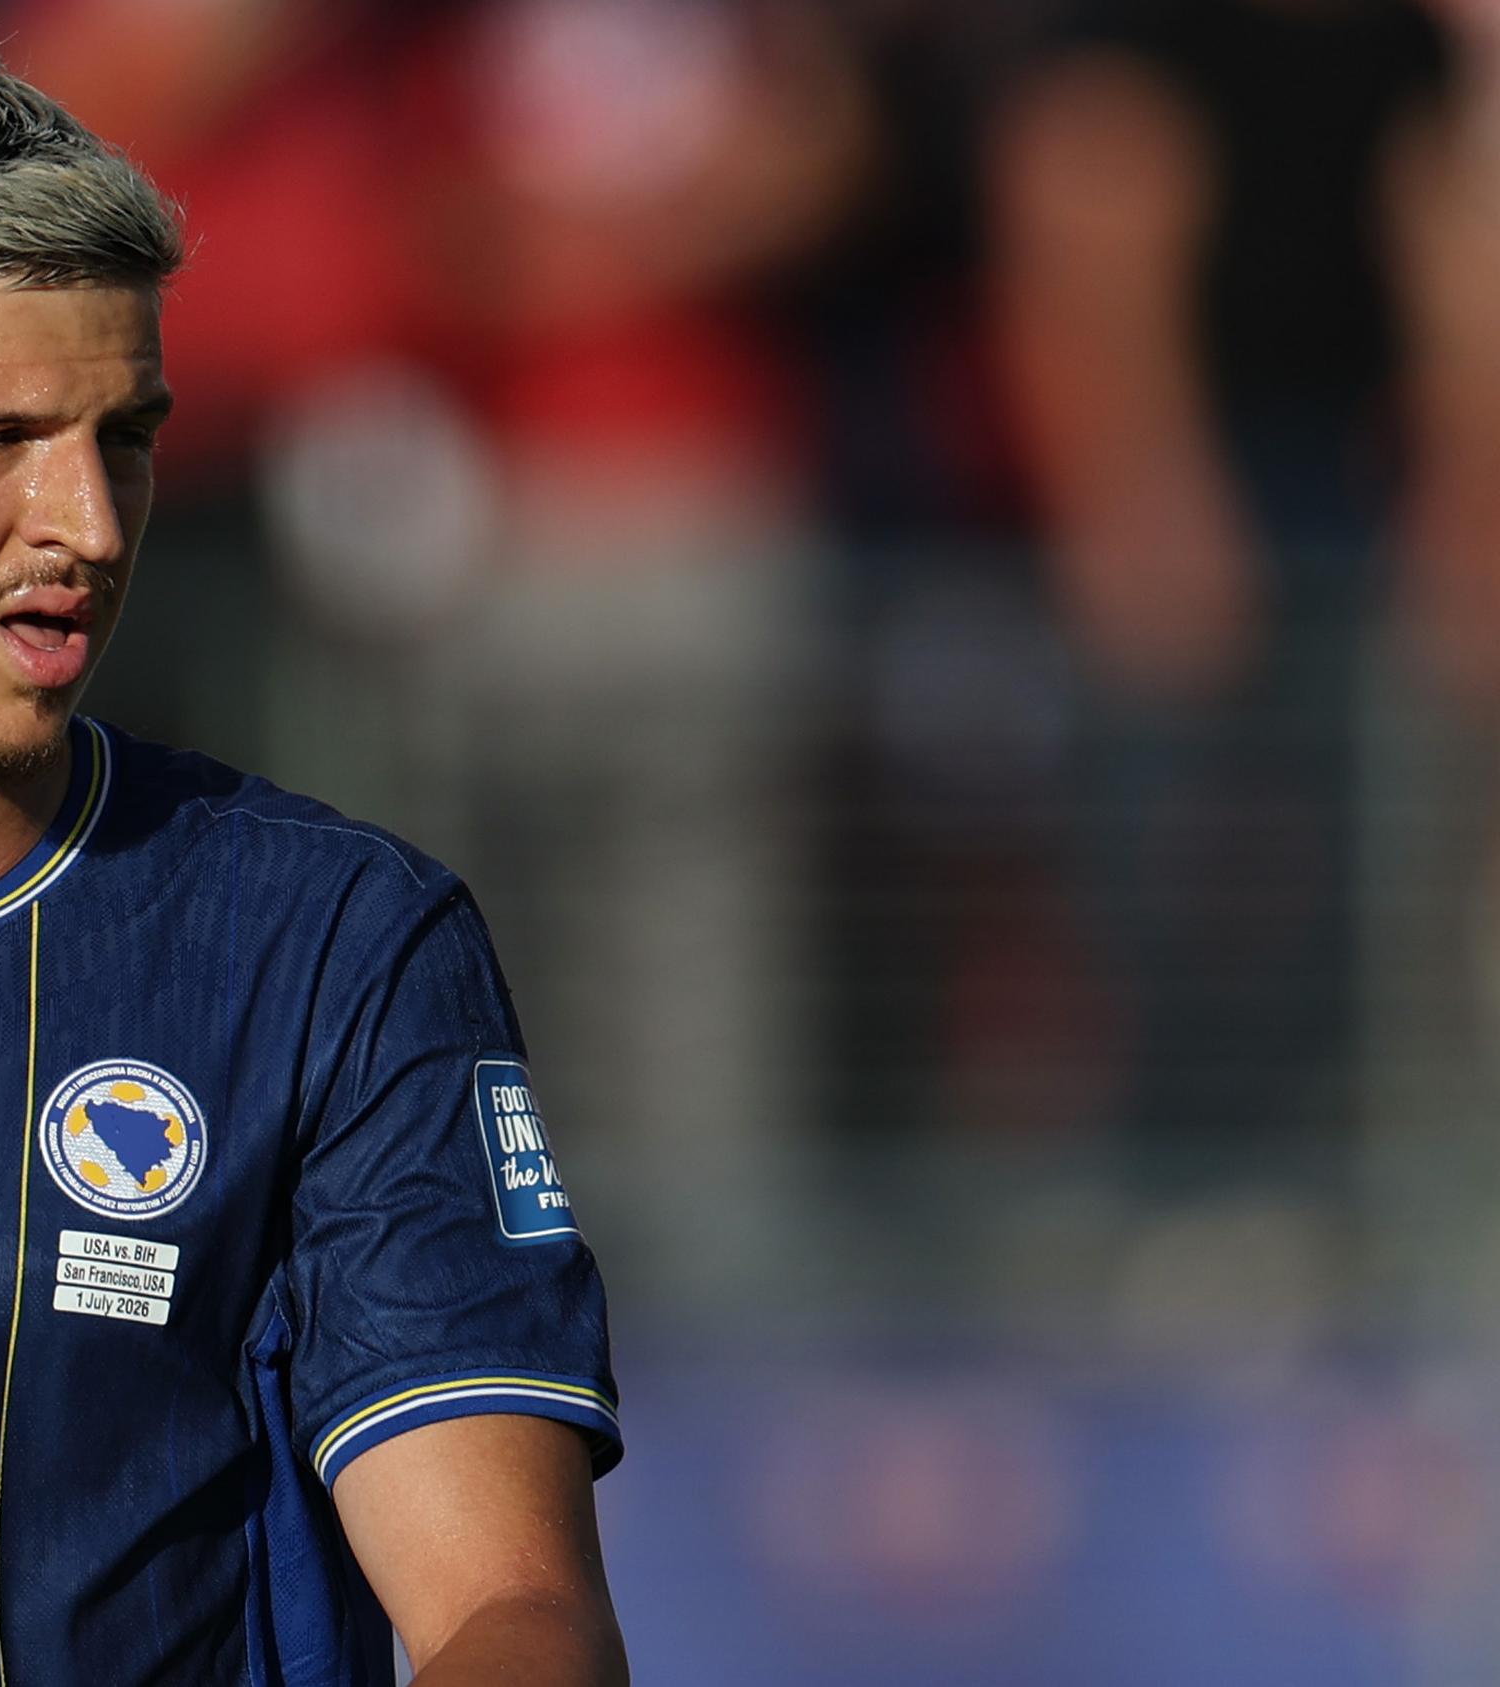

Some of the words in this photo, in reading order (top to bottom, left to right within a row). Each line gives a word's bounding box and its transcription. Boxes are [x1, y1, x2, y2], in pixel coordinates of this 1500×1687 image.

[491, 1085, 536, 1113] FOOT
[495, 1114, 548, 1154] UNI
[499, 1156, 540, 1191] the
[538, 1154, 562, 1187] W
[83, 1237, 111, 1257] USA
[114, 1245, 131, 1260] vs.
[134, 1244, 157, 1264] BIH
[64, 1262, 85, 1281] San
[76, 1291, 83, 1308] 1
[86, 1293, 113, 1316] July
[116, 1297, 150, 1317] 2026
